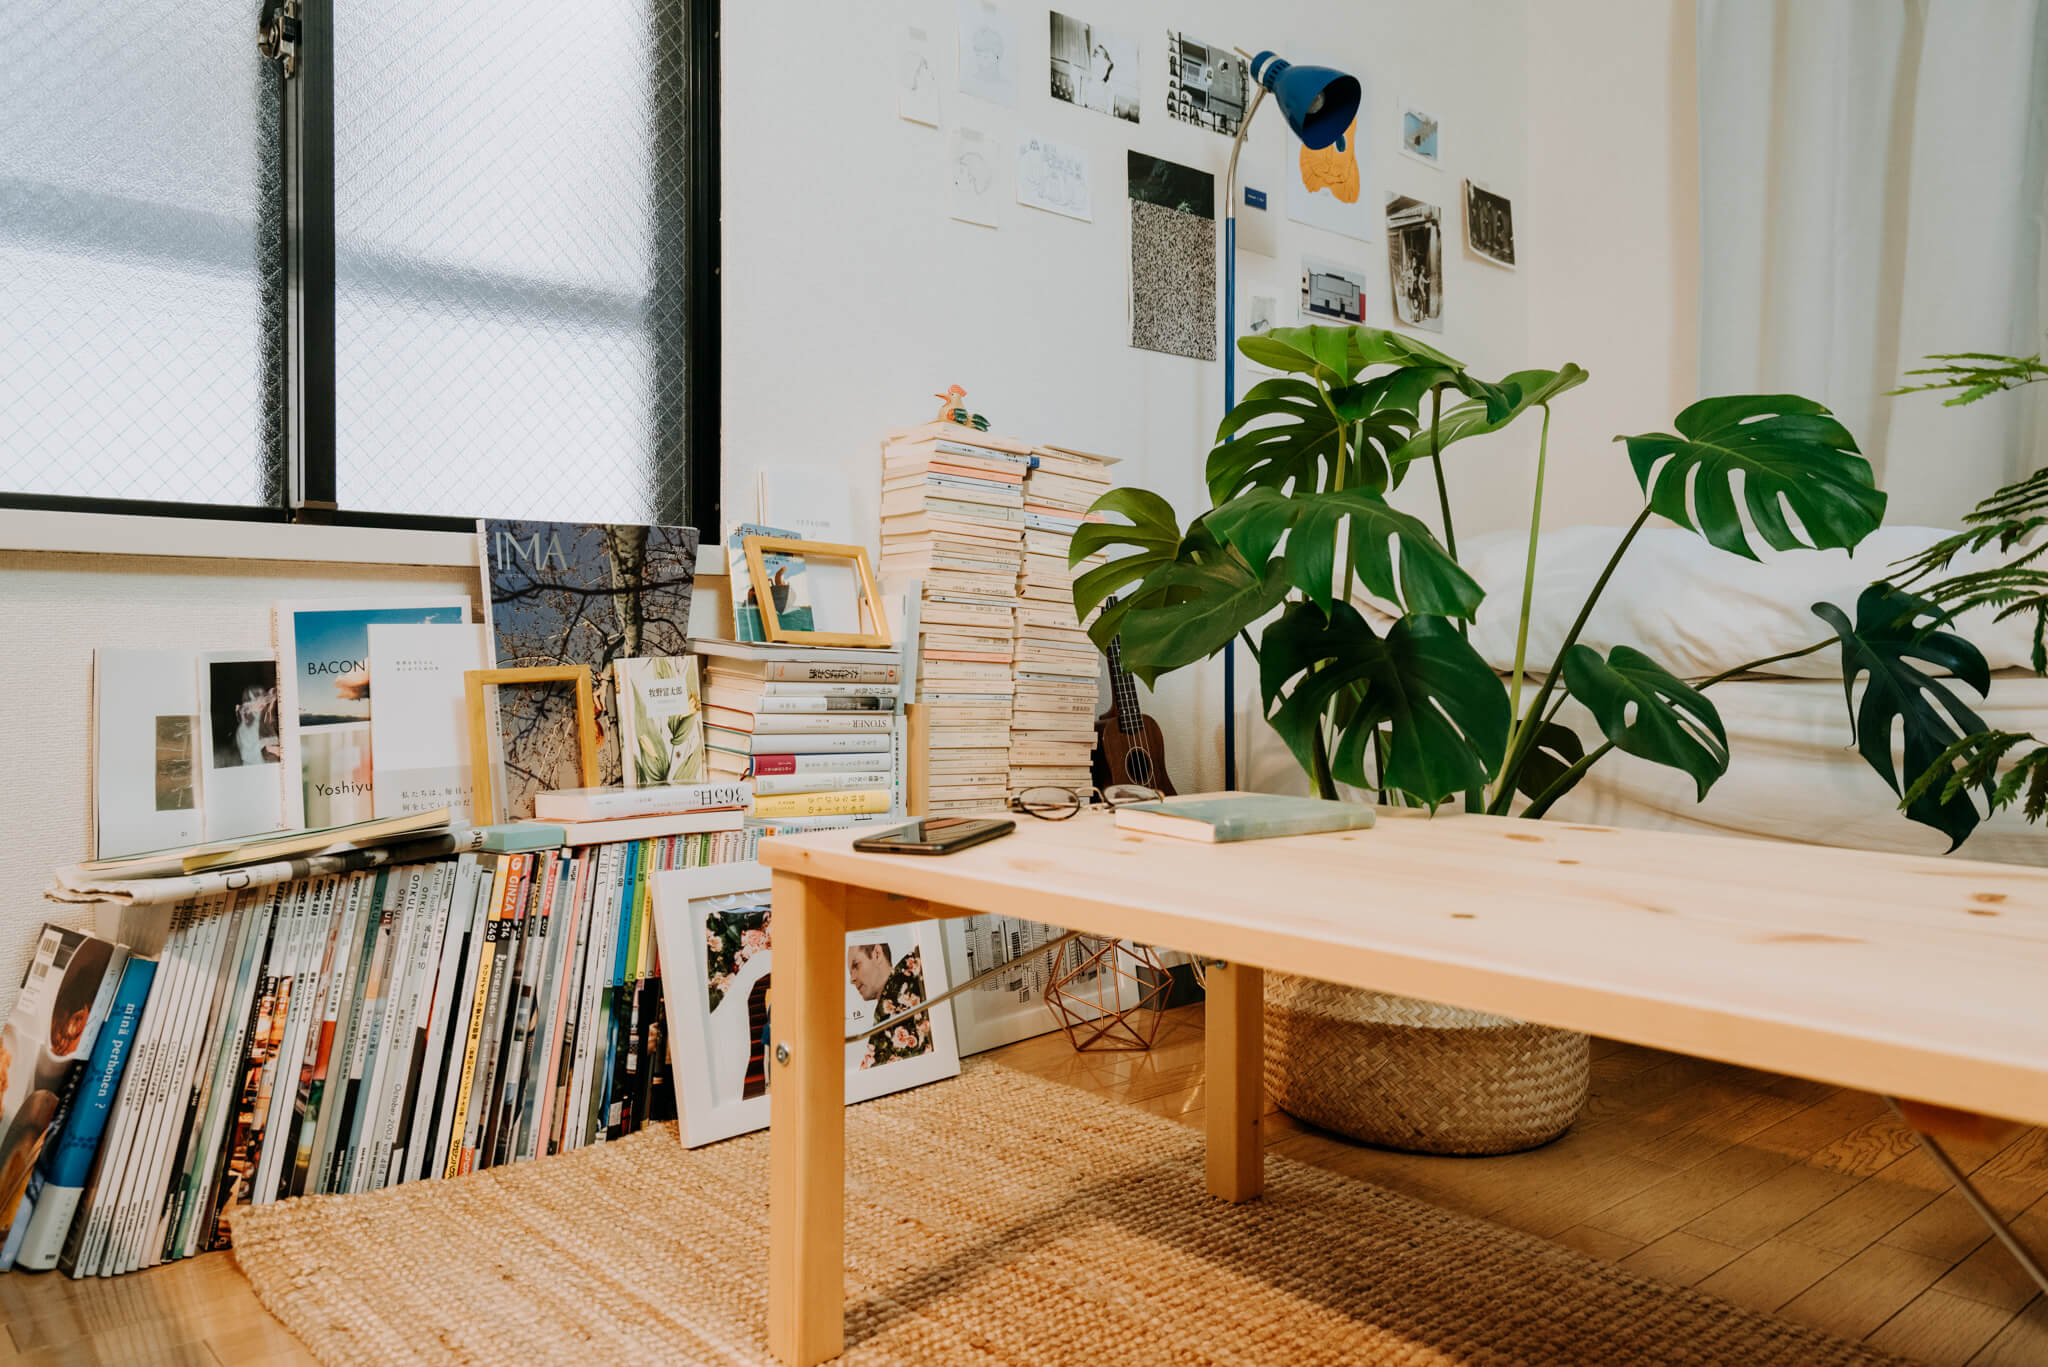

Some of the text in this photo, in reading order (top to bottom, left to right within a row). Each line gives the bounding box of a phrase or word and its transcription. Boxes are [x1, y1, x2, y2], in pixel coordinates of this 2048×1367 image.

[495, 531, 568, 571] IMA
[308, 660, 366, 676] BACON
[852, 719, 887, 728] STONER
[501, 875, 519, 938] GINZA 214
[486, 922, 498, 941] 249
[97, 1038, 126, 1098] perhonen
